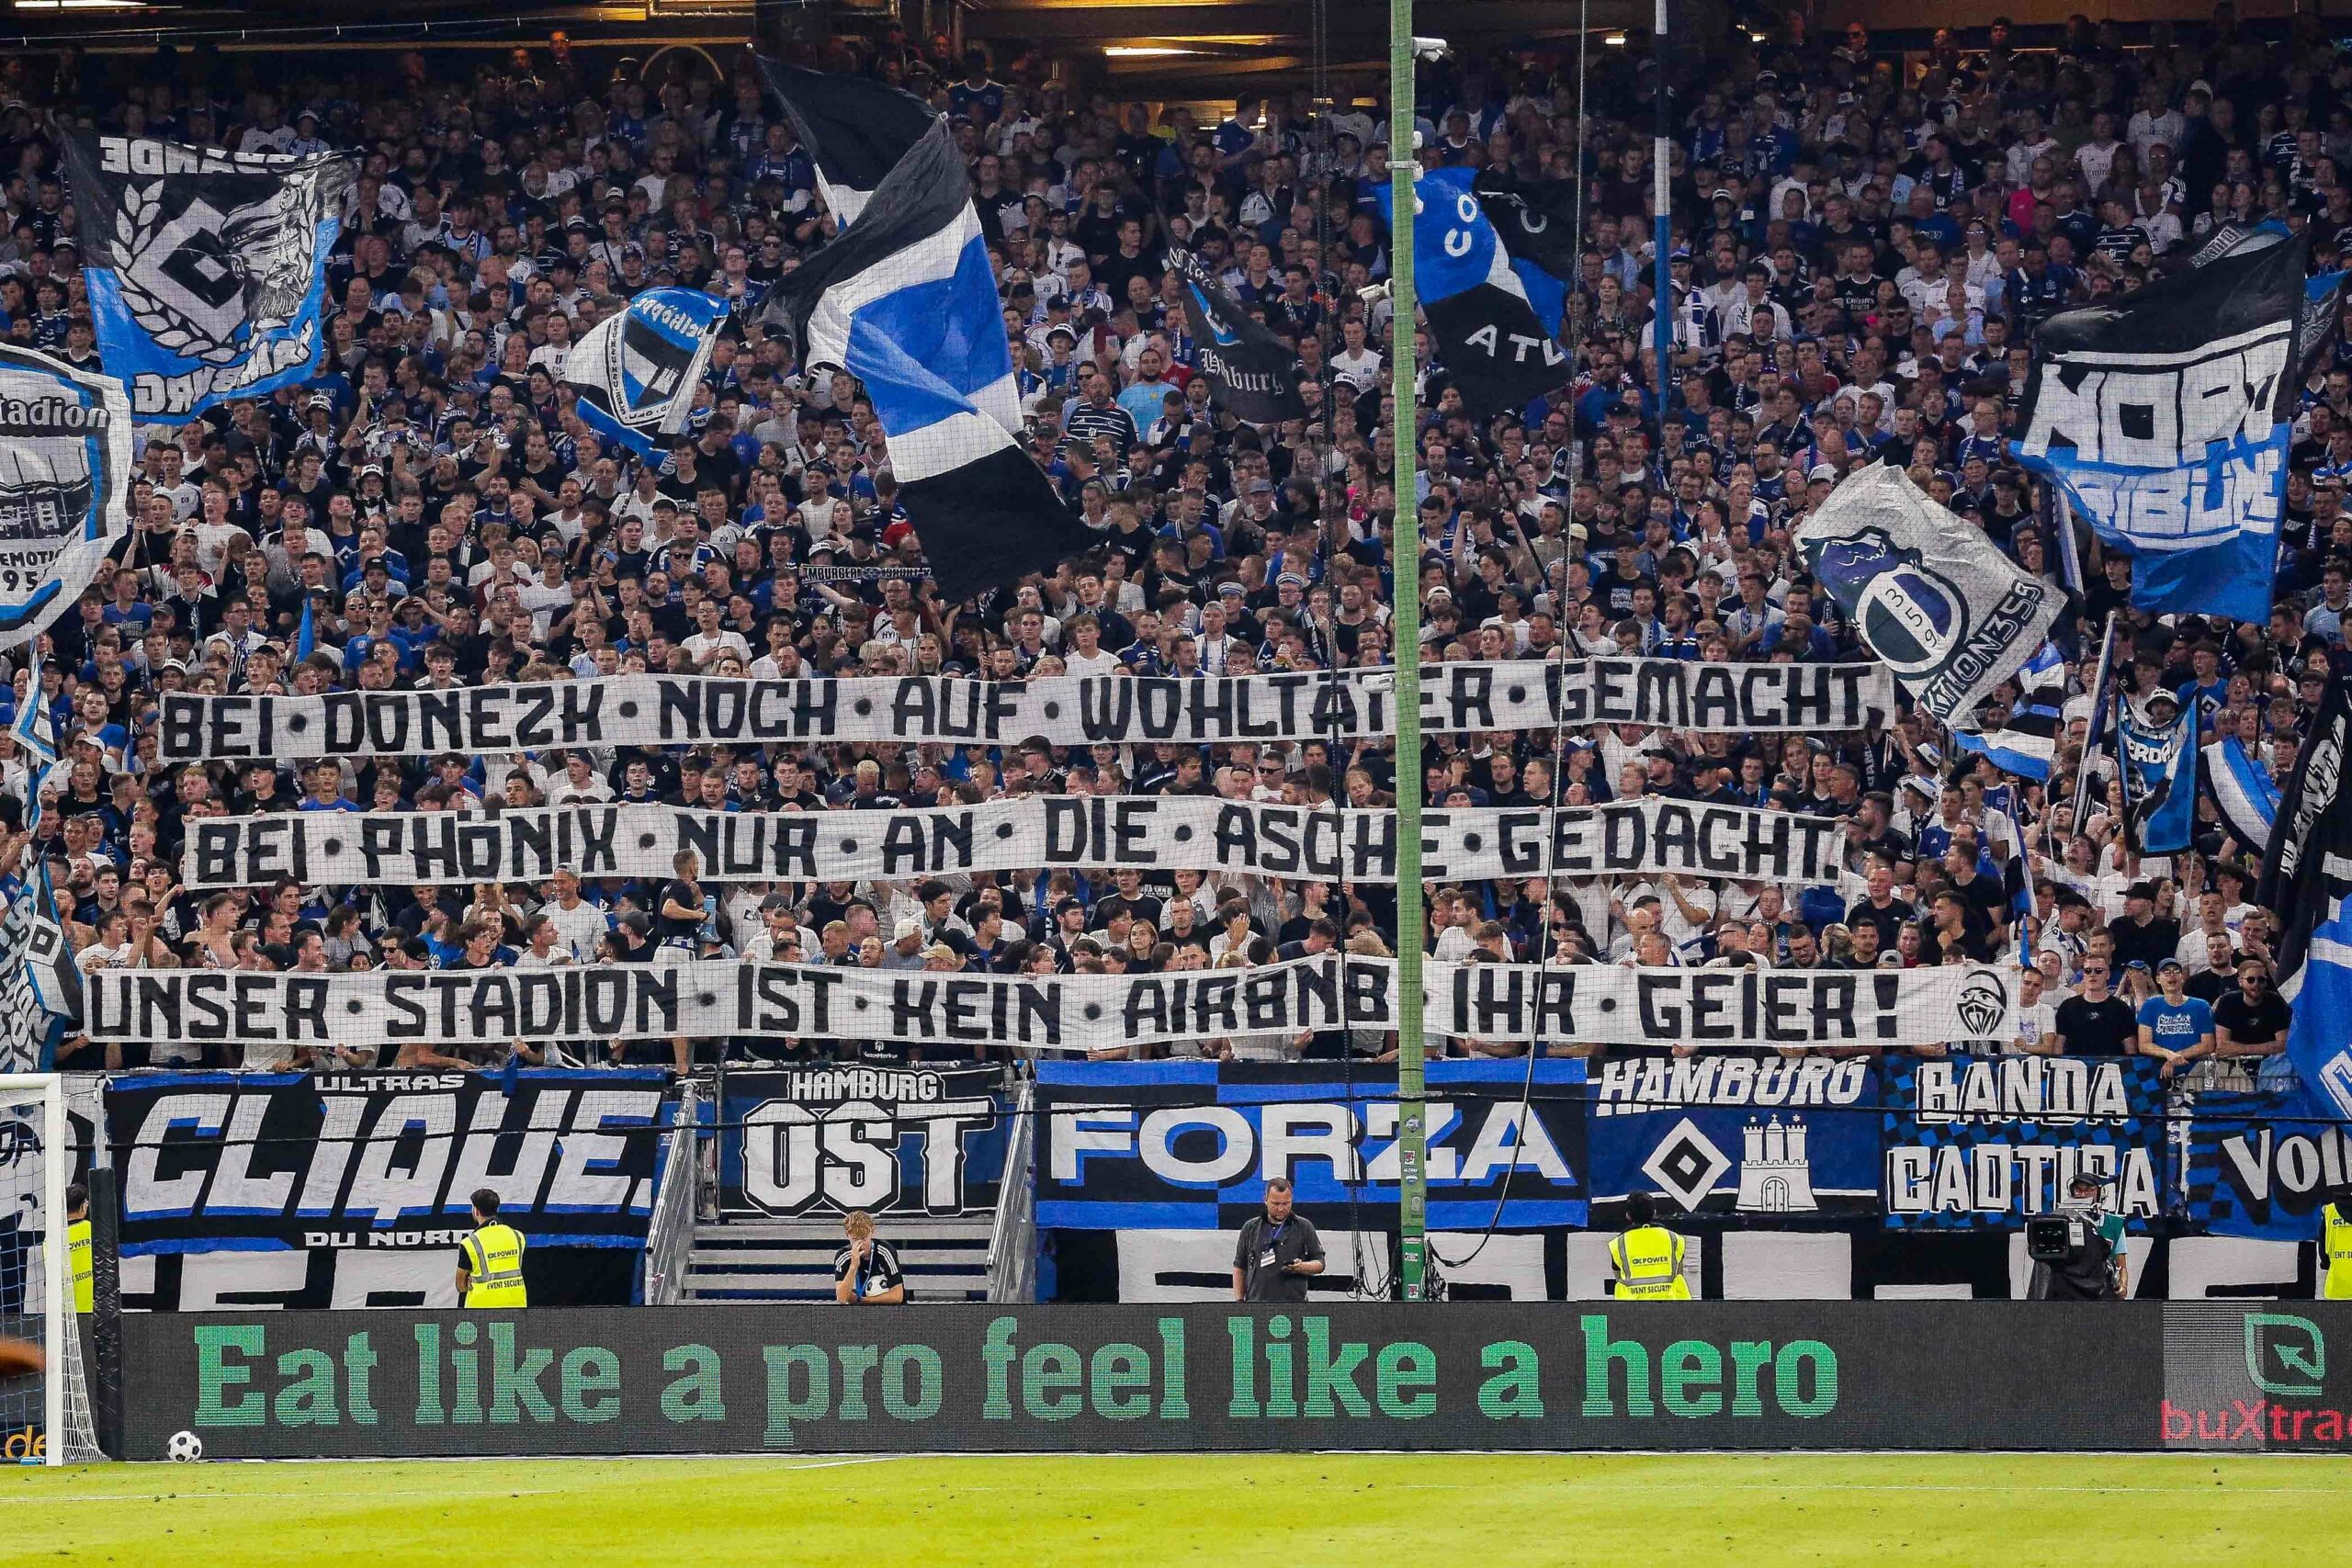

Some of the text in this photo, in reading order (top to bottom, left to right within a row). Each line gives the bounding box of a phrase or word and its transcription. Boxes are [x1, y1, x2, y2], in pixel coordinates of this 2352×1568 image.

[162, 696, 273, 757] BEI
[324, 683, 604, 752] DONEZK
[659, 678, 835, 741] NOCH
[890, 676, 1024, 740] AUF
[1080, 667, 1493, 741] WOHLTÄTER
[195, 819, 308, 884] BEI
[359, 808, 617, 879] PHÖNIX
[676, 814, 817, 876] NUR
[882, 812, 974, 874] AN
[1045, 798, 1159, 863] DIE
[1215, 804, 1452, 875] ASCHE
[91, 957, 1899, 1044] UNSER STADION IST KEIN AIRBNB IHR GEIER!
[313, 1074, 467, 1092] ULTRAS
[791, 1070, 938, 1101] HAMBURG
[1594, 1054, 1871, 1118] HAMBURG
[1916, 1056, 2131, 1126] BANDA
[742, 1100, 990, 1209] OST
[1050, 1102, 1574, 1183] FORZA
[303, 1231, 361, 1247] DU
[1643, 1256, 1668, 1264] POWER
[195, 1314, 1838, 1447] Eat like a pro feel like a hero
[2161, 1399, 2352, 1442] buXtra
